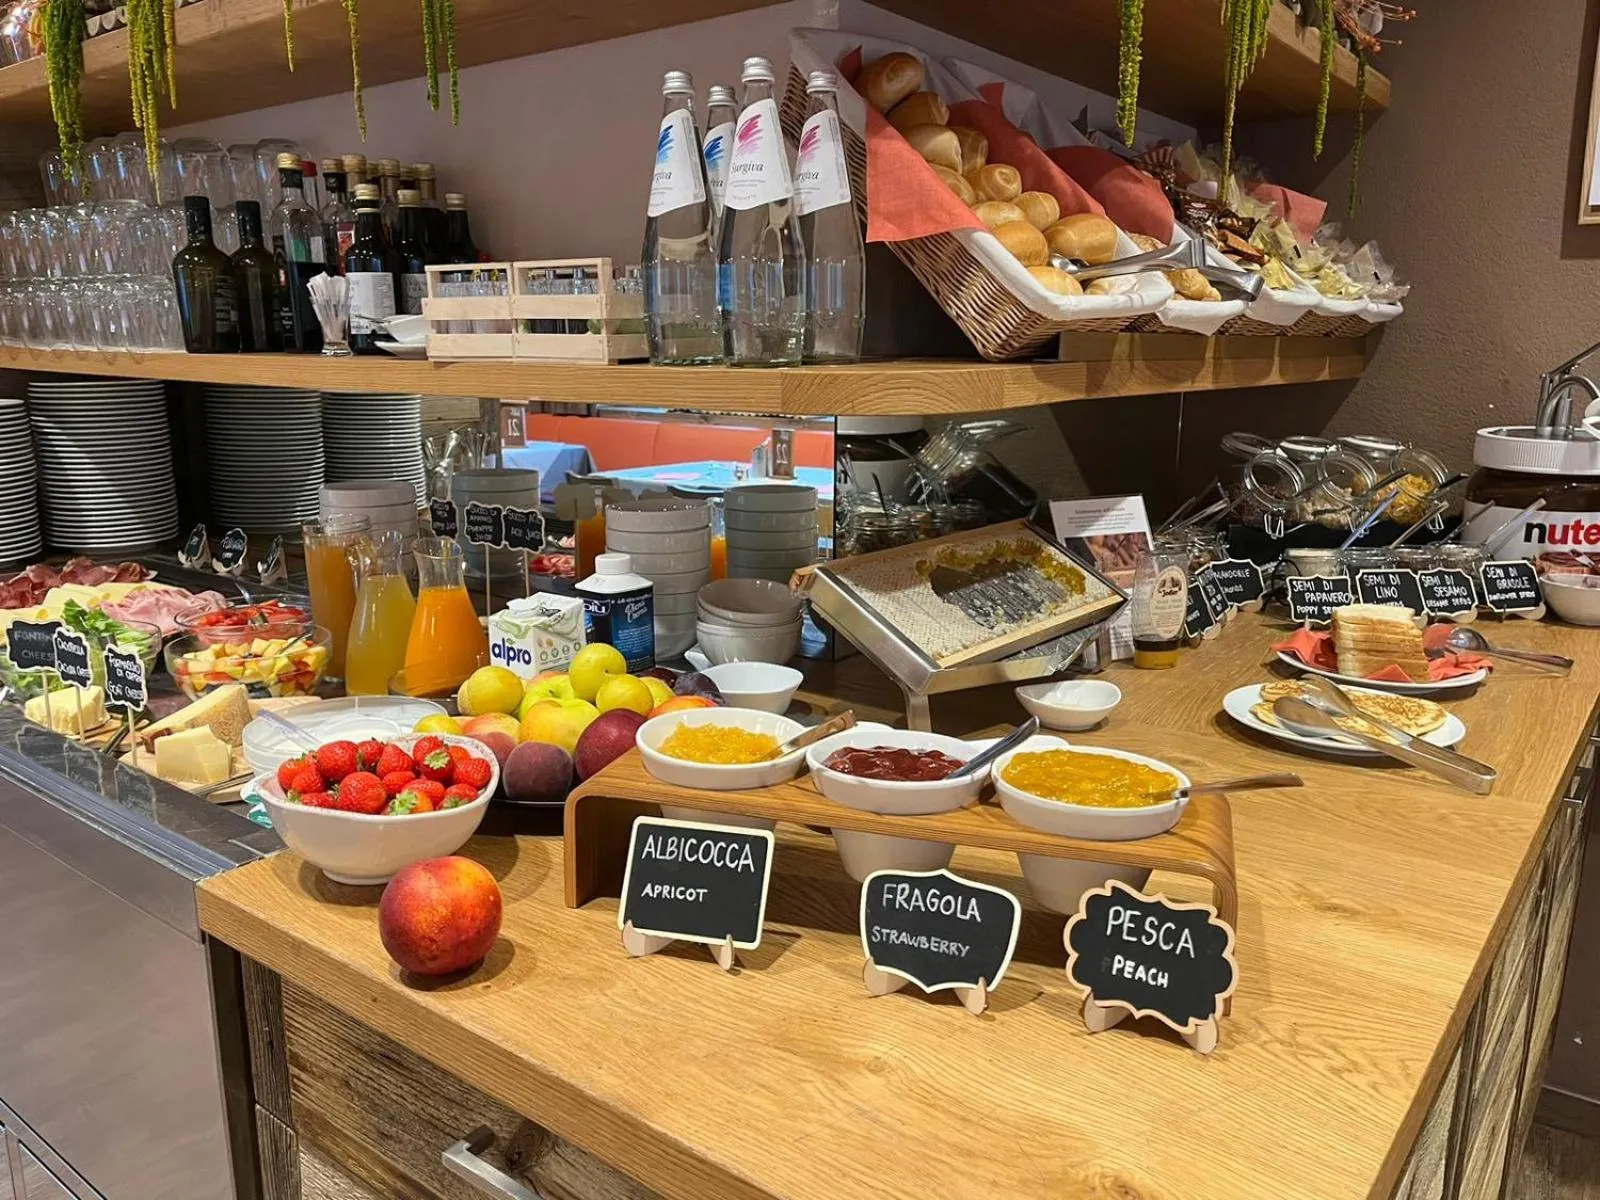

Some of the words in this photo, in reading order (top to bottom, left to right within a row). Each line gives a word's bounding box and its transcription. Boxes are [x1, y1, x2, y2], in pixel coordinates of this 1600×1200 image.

[1486, 566, 1504, 578] SEMI
[1508, 566, 1518, 577] DI
[1292, 580, 1316, 592] SEMI
[1323, 580, 1334, 591] DI
[1361, 575, 1386, 587] SEMI
[1388, 573, 1401, 585] DI
[1421, 574, 1441, 588] SEMI
[1444, 574, 1455, 585] DI
[1304, 591, 1350, 604] PAPAVERO
[1374, 586, 1399, 599] LINO
[1433, 586, 1468, 598] SESAMO
[1296, 605, 1318, 614] POPPY
[15, 631, 53, 641] FONTIN
[491, 637, 532, 667] alpro
[641, 834, 755, 873] ALBICOCCA
[640, 882, 709, 902] APRICOT
[882, 882, 982, 923] FRAGOLA
[1106, 905, 1195, 959] PESCA
[870, 925, 971, 959] STRAWBERRY
[1111, 954, 1169, 989] PEACH
